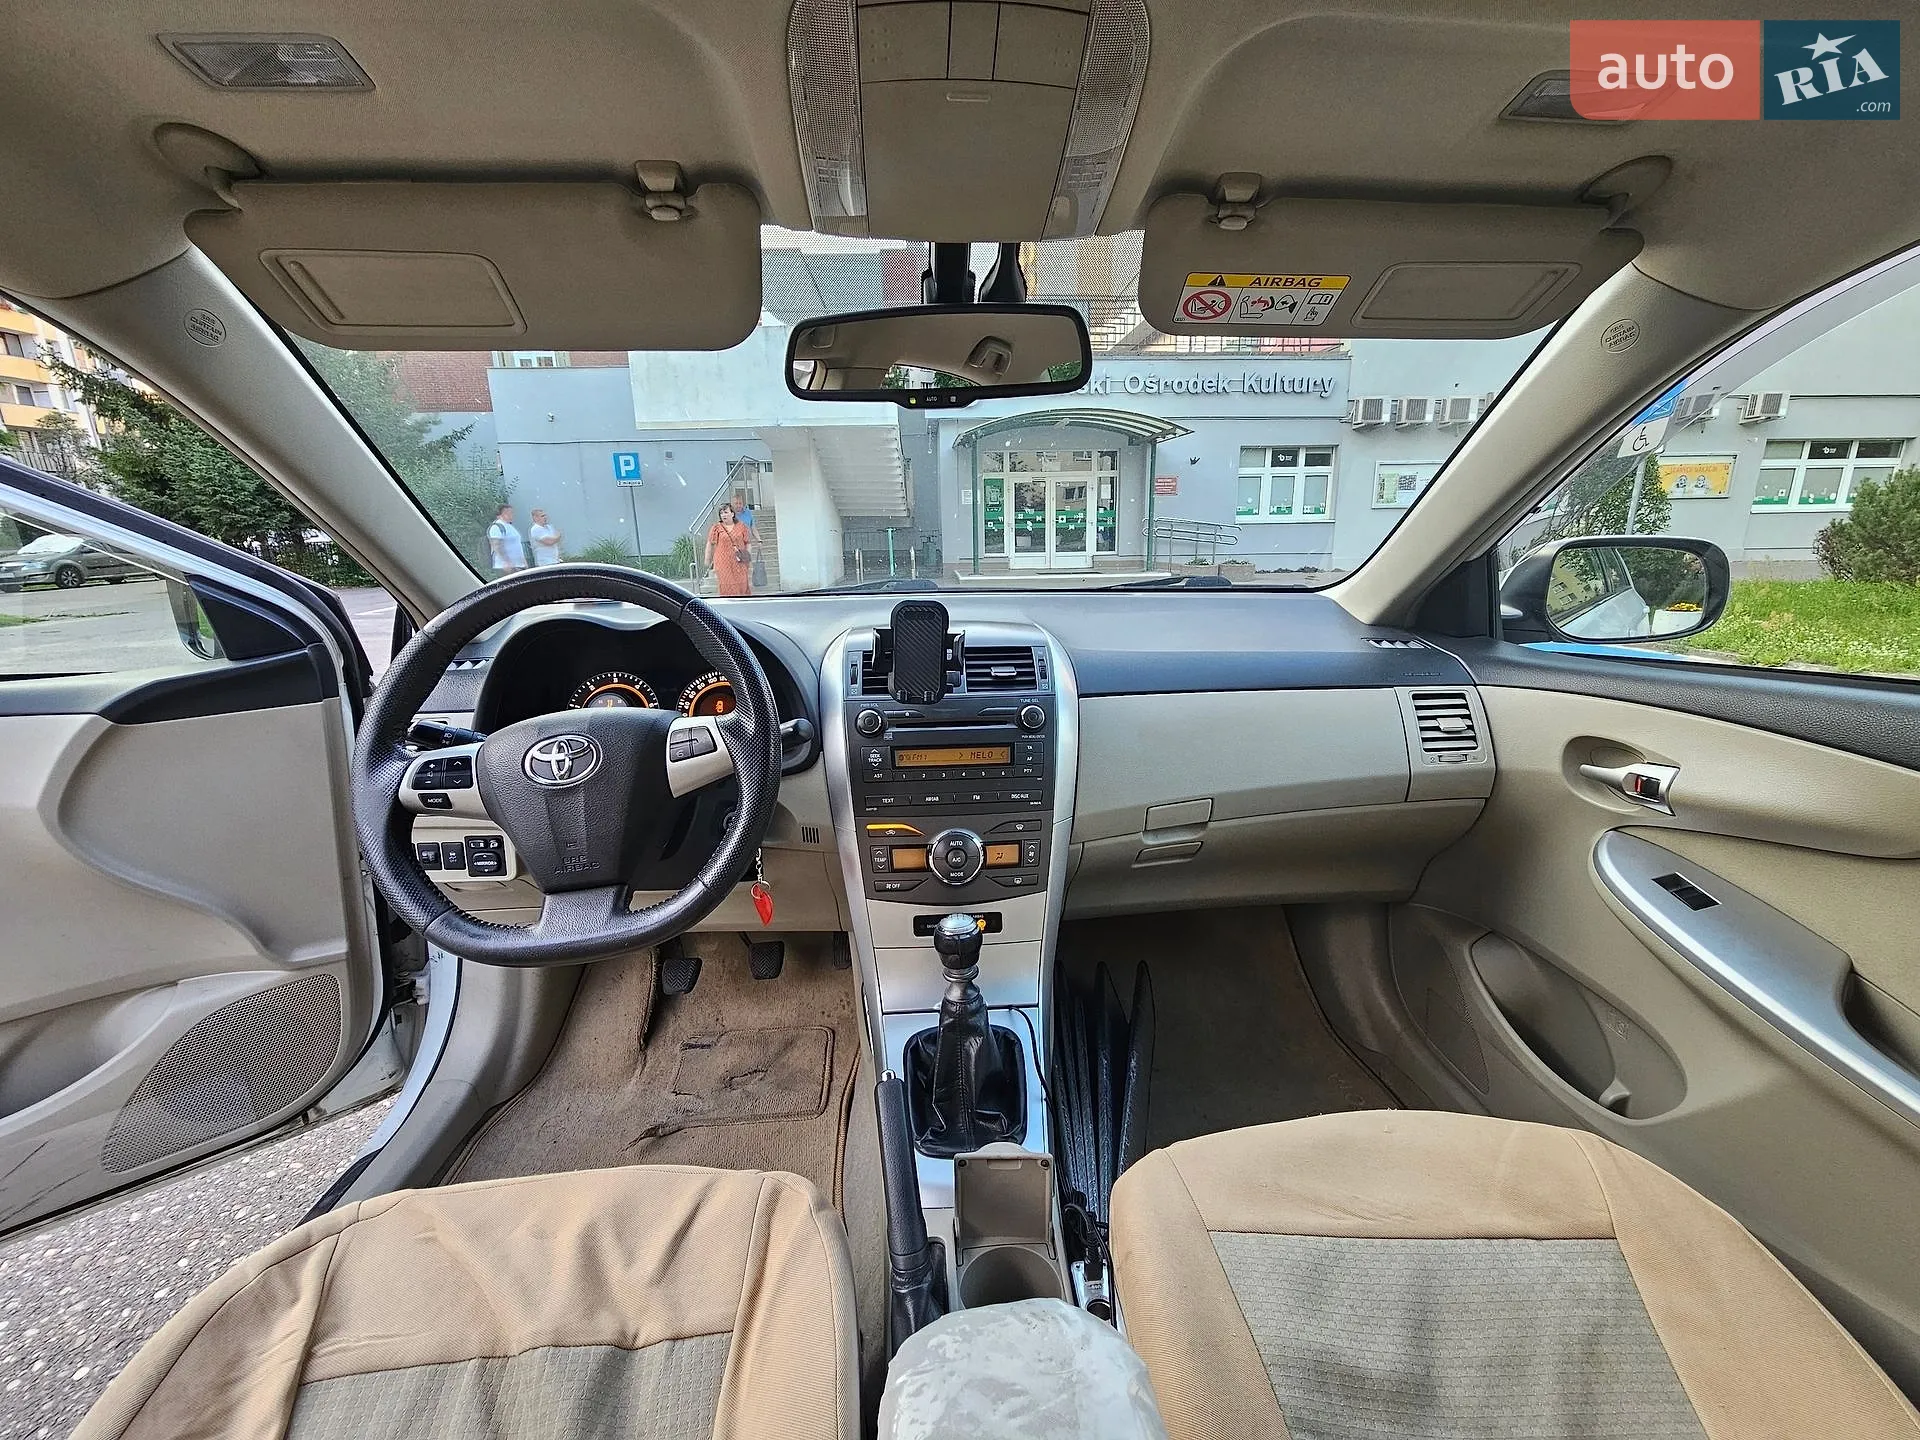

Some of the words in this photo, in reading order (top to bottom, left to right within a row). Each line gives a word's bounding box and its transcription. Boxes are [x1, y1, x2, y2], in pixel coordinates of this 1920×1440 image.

[1250, 277, 1323, 288] AIRBAG
[1124, 372, 1231, 395] Ośrodek
[1243, 372, 1336, 398] Kultury
[619, 455, 636, 477] P
